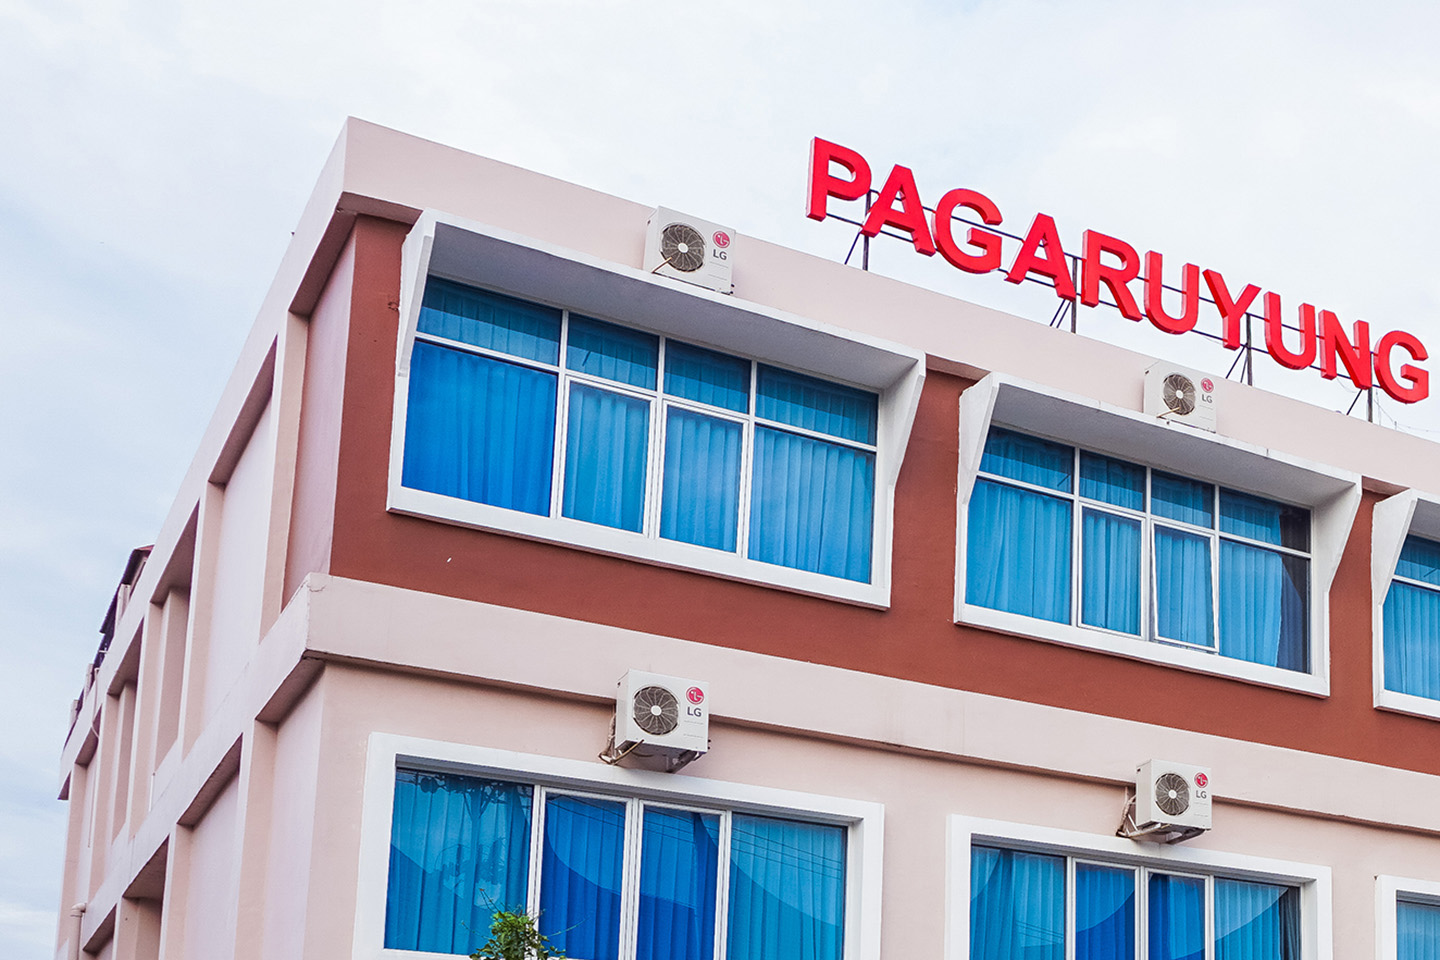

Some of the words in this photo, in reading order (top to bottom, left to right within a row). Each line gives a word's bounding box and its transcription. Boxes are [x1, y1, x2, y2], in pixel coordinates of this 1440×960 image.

[713, 249, 727, 261] LG
[808, 138, 1428, 404] PAGARUYUNG
[1201, 394, 1213, 404] LG
[687, 706, 702, 718] LG
[1196, 790, 1207, 799] LG
